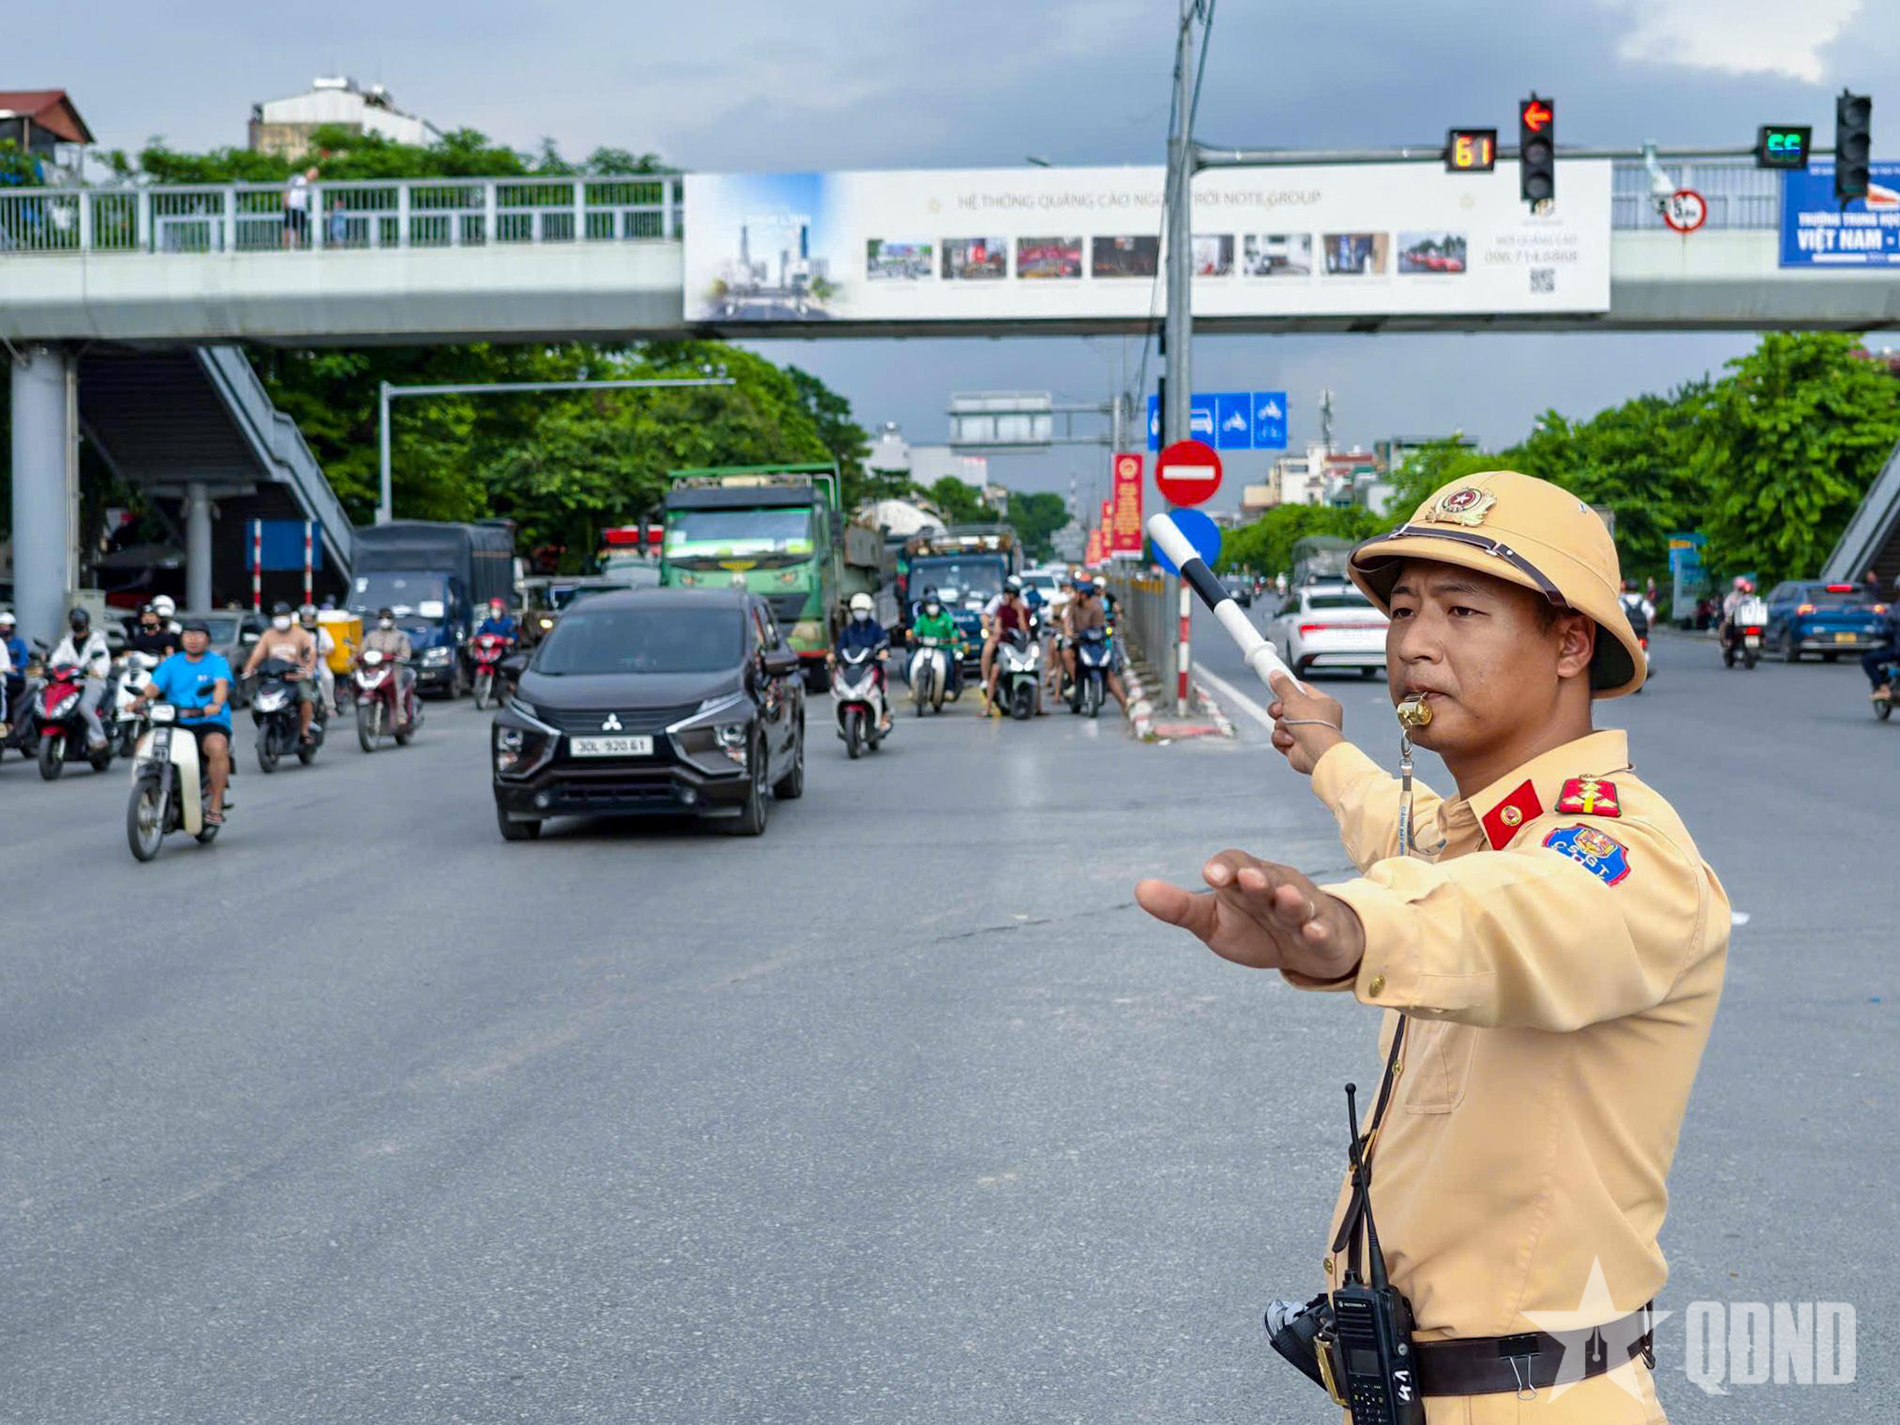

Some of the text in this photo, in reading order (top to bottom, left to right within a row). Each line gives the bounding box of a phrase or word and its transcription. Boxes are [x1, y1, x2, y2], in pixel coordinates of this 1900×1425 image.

[1455, 136, 1490, 166] 61
[1797, 227, 1836, 253] VIỆT
[1839, 229, 1882, 251] NAM
[1553, 841, 1610, 879] CSGT
